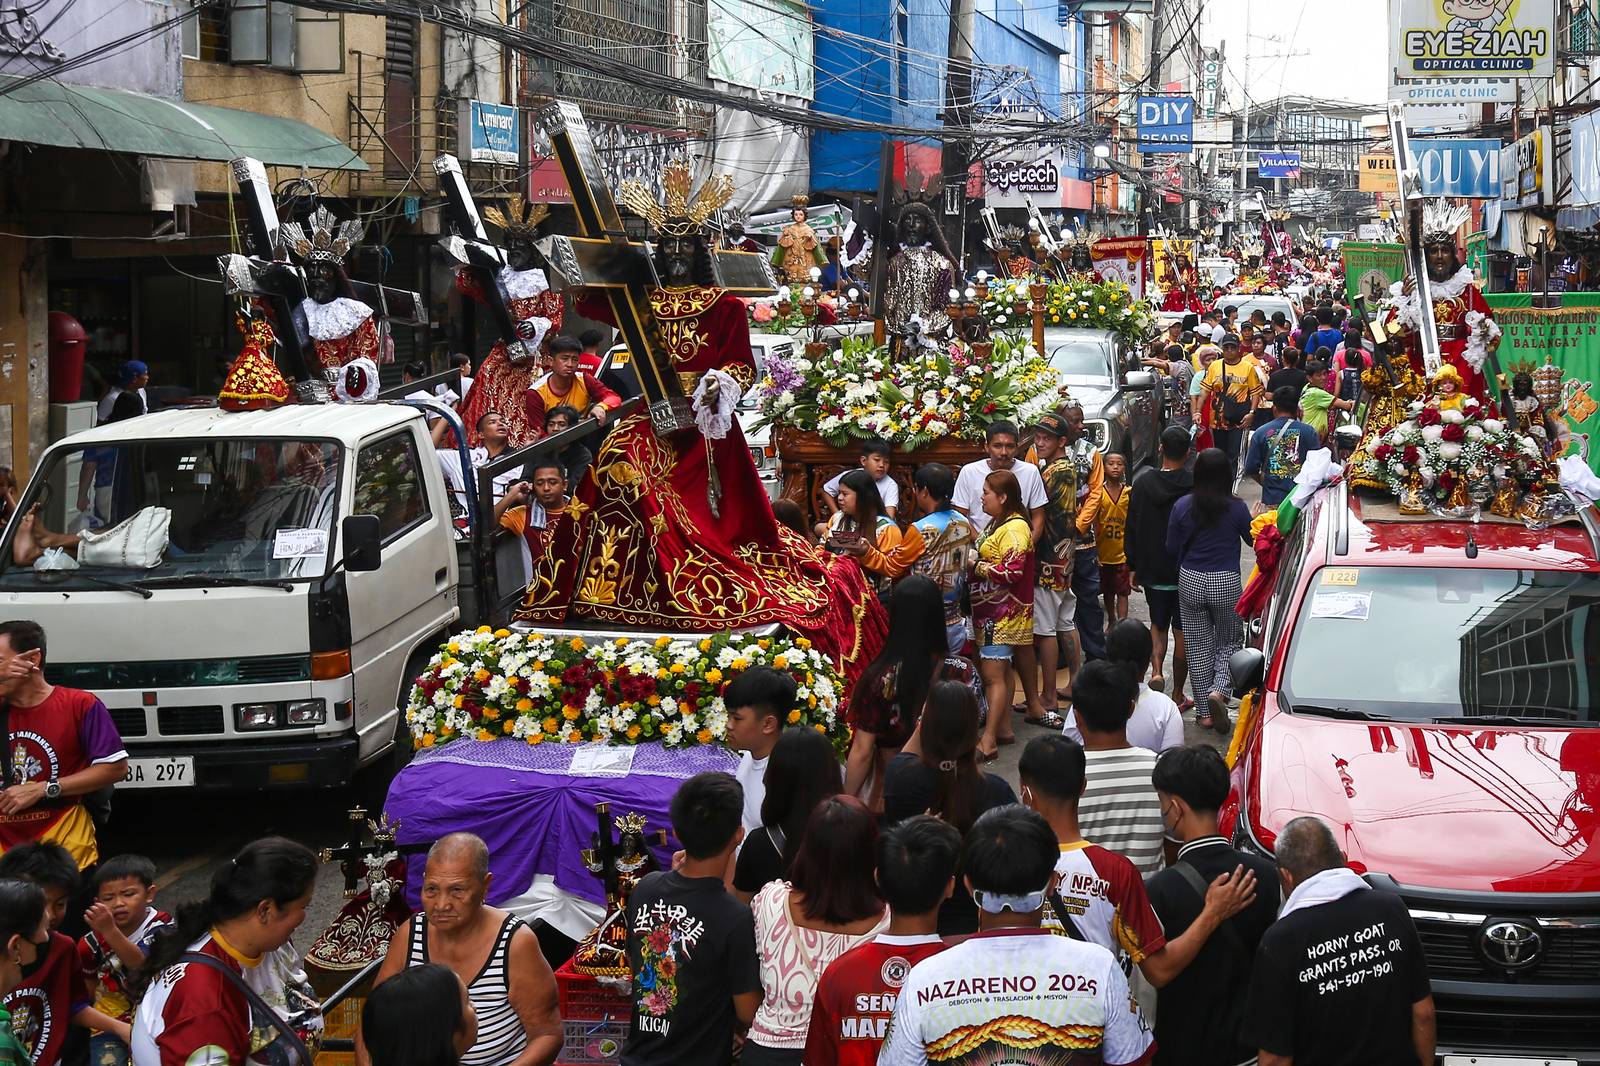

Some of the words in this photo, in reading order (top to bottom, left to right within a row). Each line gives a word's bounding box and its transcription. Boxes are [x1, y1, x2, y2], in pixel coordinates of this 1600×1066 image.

[1406, 30, 1546, 56] EYE-ZIAH
[1423, 60, 1476, 69] OPTICAL
[1481, 60, 1524, 69] CLINIC
[1408, 88, 1457, 98] OPTICAL
[1459, 88, 1498, 97] CLINIC
[1141, 102, 1189, 125] DIY
[1141, 134, 1189, 145] BEADS
[988, 160, 1058, 191] eyetech
[1019, 184, 1039, 192] OPTICAL
[1513, 337, 1579, 349] BALANGAY
[156, 763, 186, 781] 297
[633, 898, 705, 961] 生き甲斐
[1307, 934, 1349, 960] HORNY
[1354, 922, 1385, 944] GOAT
[1299, 956, 1348, 983] GRANTS
[1349, 944, 1385, 966] PASS,
[1388, 939, 1403, 951] OR
[1318, 960, 1393, 995] 541-507-1901
[916, 974, 1037, 1007] NAZARENO
[948, 997, 982, 1007] DEBOSYON
[993, 995, 1034, 1003] TRASLACION
